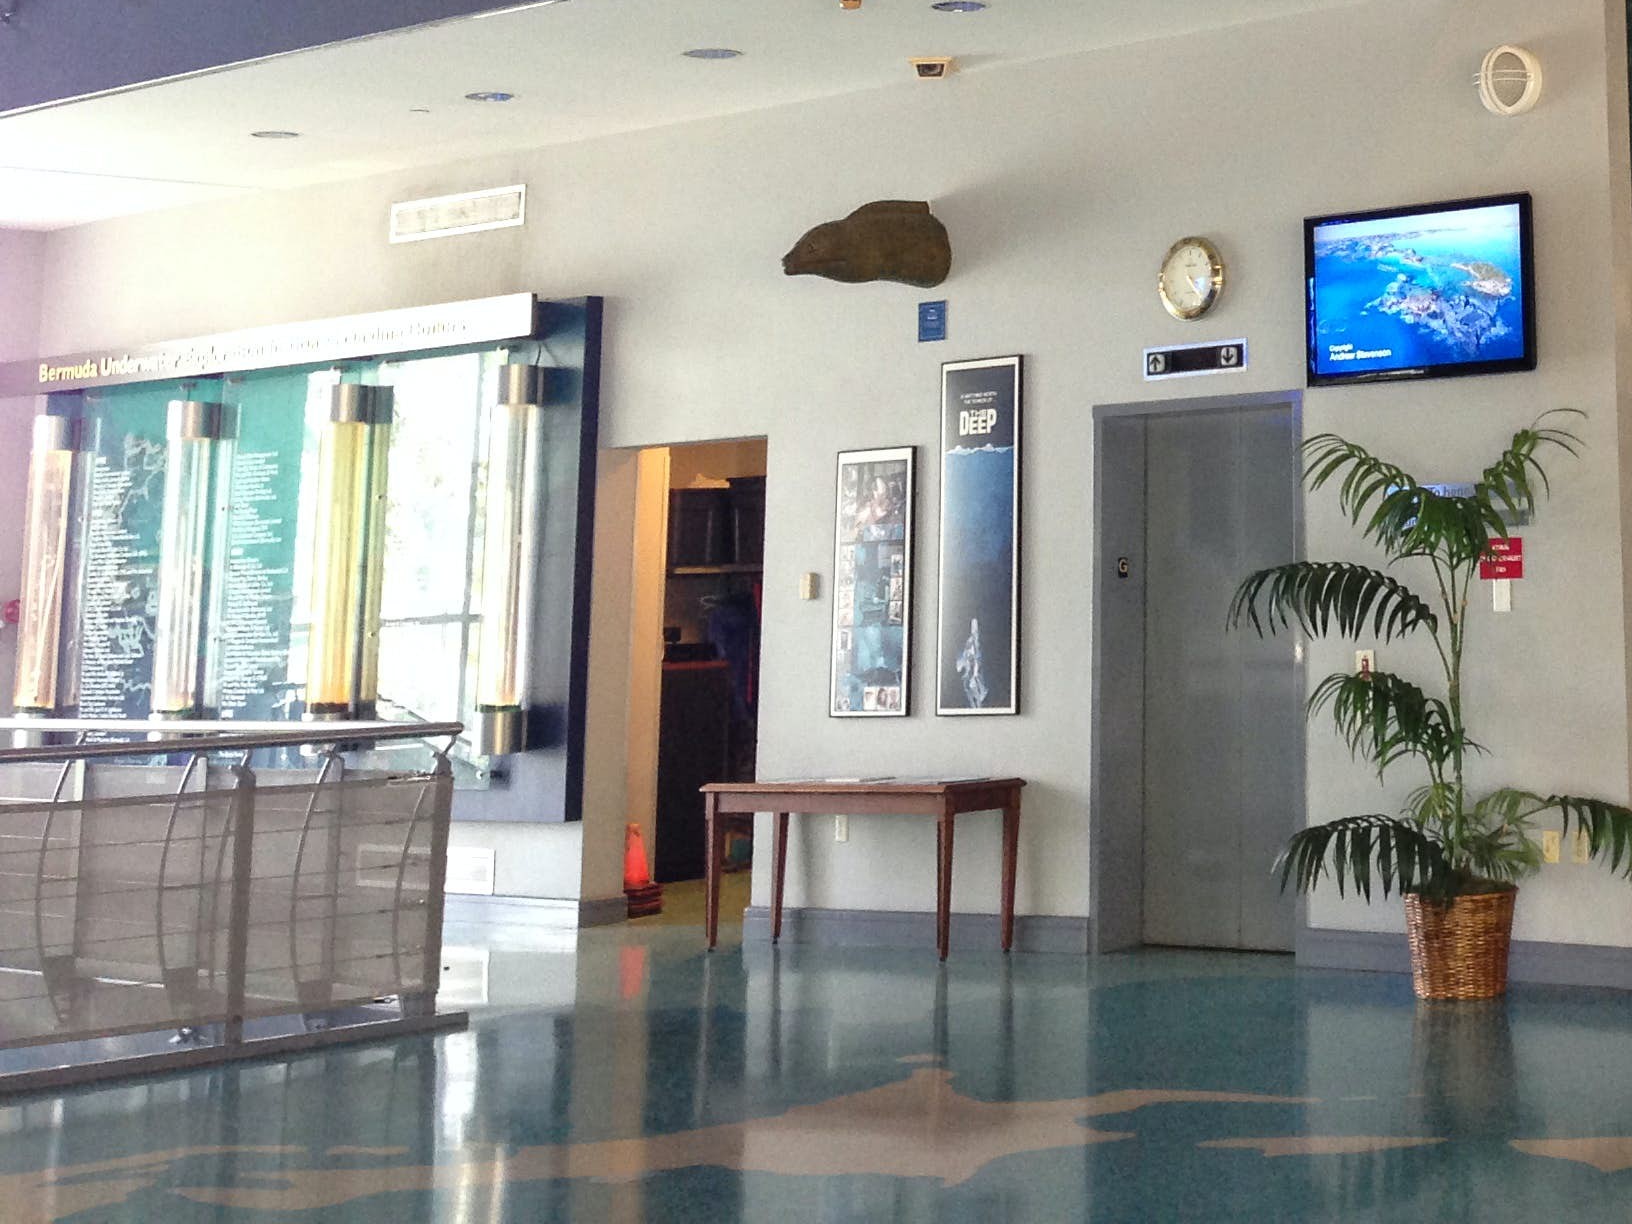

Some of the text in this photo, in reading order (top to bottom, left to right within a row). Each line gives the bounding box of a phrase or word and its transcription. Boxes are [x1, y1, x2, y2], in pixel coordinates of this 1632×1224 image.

[38, 358, 99, 383] Bermuda
[959, 408, 997, 437] DEEP
[1119, 559, 1129, 573] G
